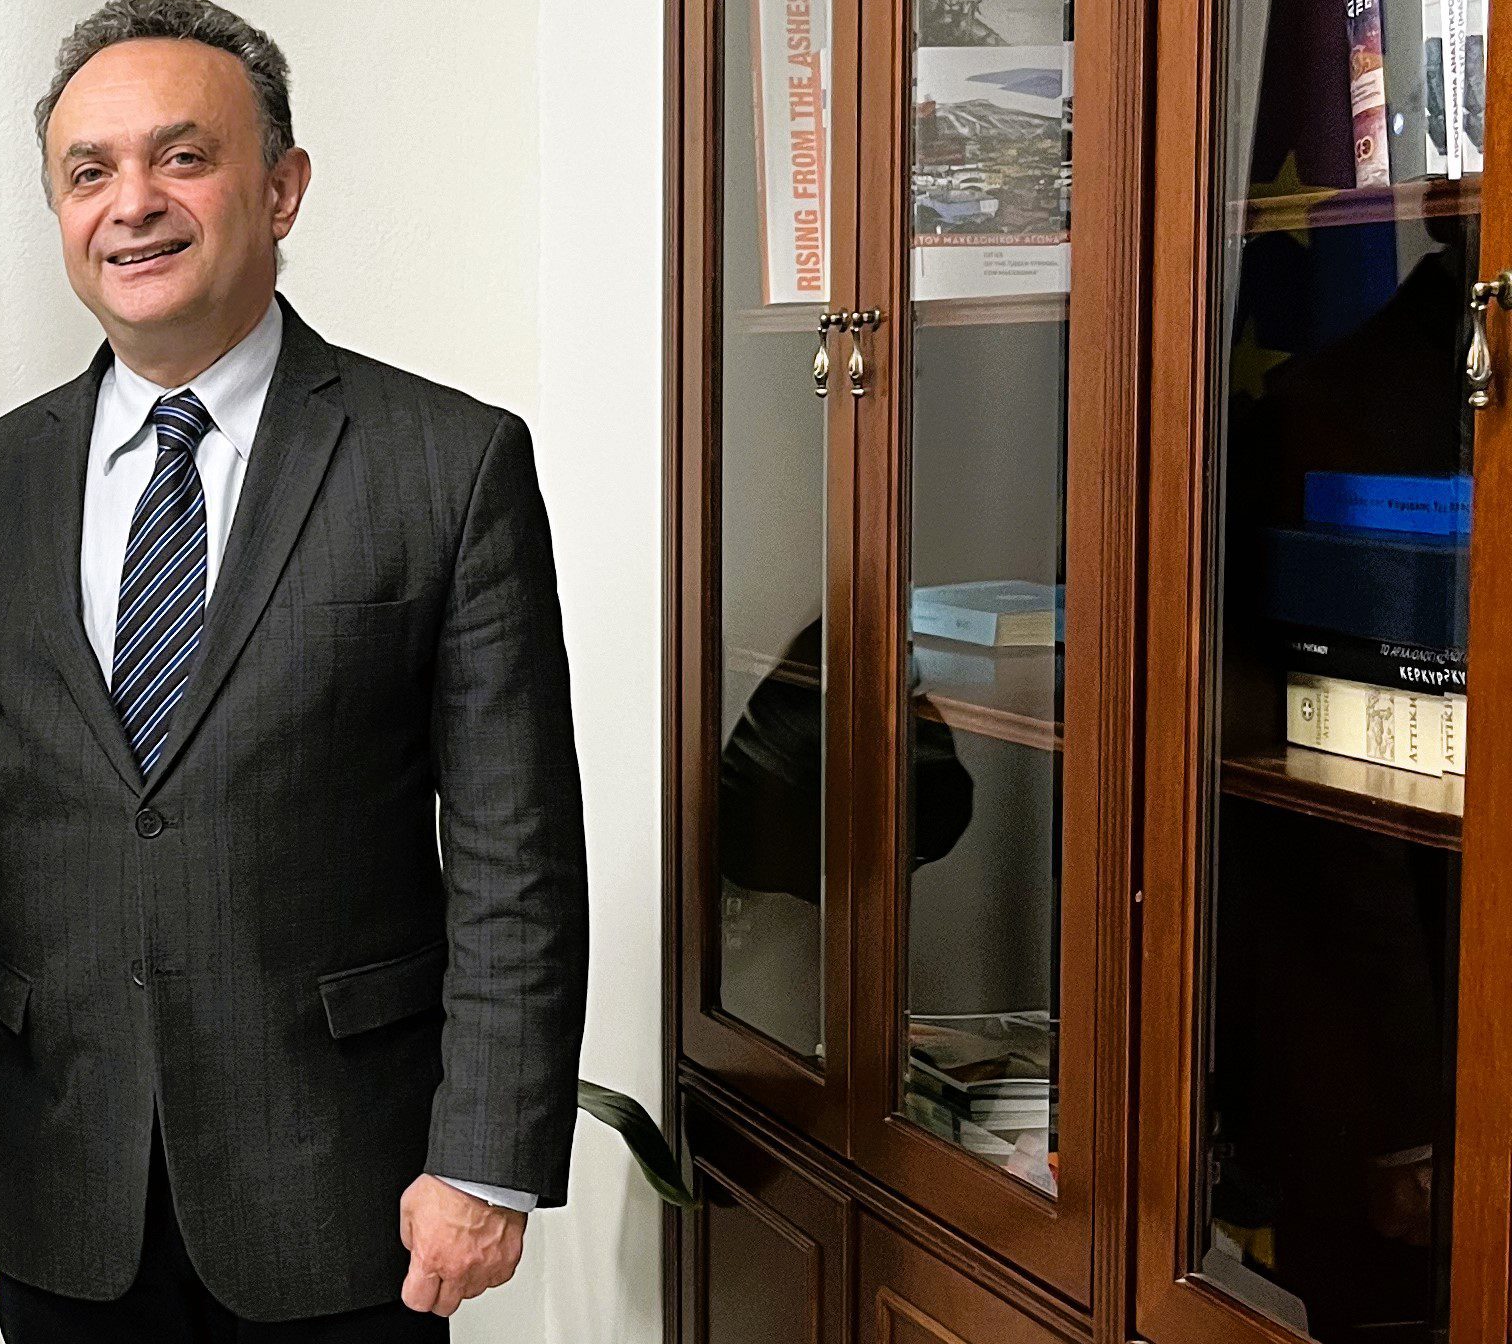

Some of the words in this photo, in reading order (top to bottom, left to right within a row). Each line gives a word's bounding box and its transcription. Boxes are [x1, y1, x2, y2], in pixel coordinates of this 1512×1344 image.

[787, 75, 814, 122] THE
[790, 130, 818, 200] FROM
[793, 209, 822, 292] RISING
